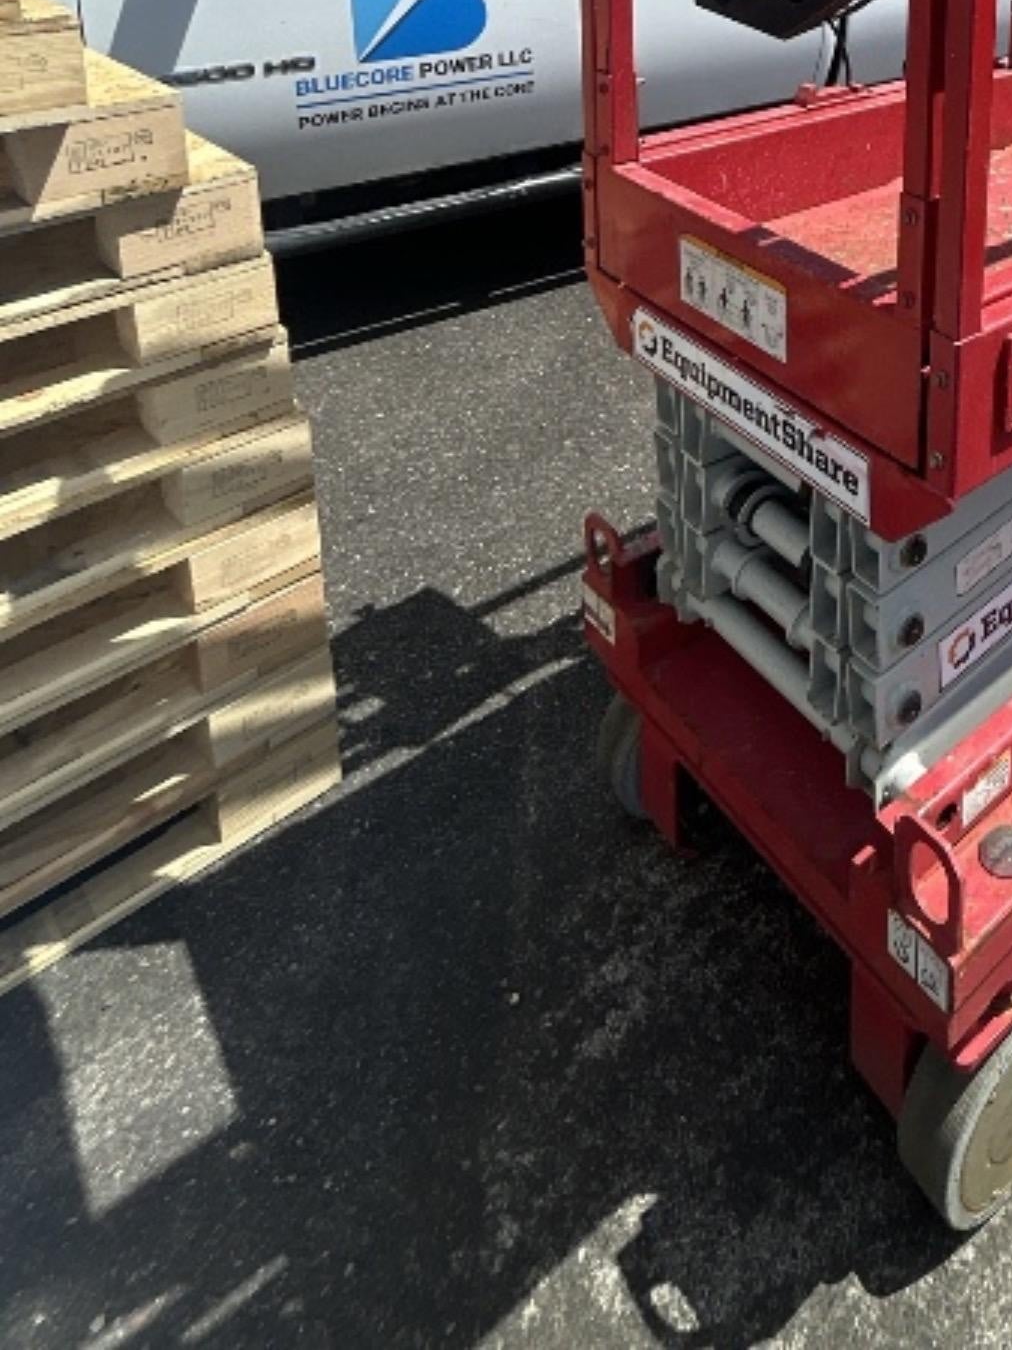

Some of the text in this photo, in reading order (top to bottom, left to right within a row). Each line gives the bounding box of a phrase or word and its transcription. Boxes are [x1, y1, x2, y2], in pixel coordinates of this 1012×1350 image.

[295, 48, 532, 96] BLUECORE POWER LLC
[298, 106, 369, 130] POWER
[436, 92, 457, 107] AT
[460, 87, 491, 104] THE
[660, 334, 859, 497] EquipmentShare
